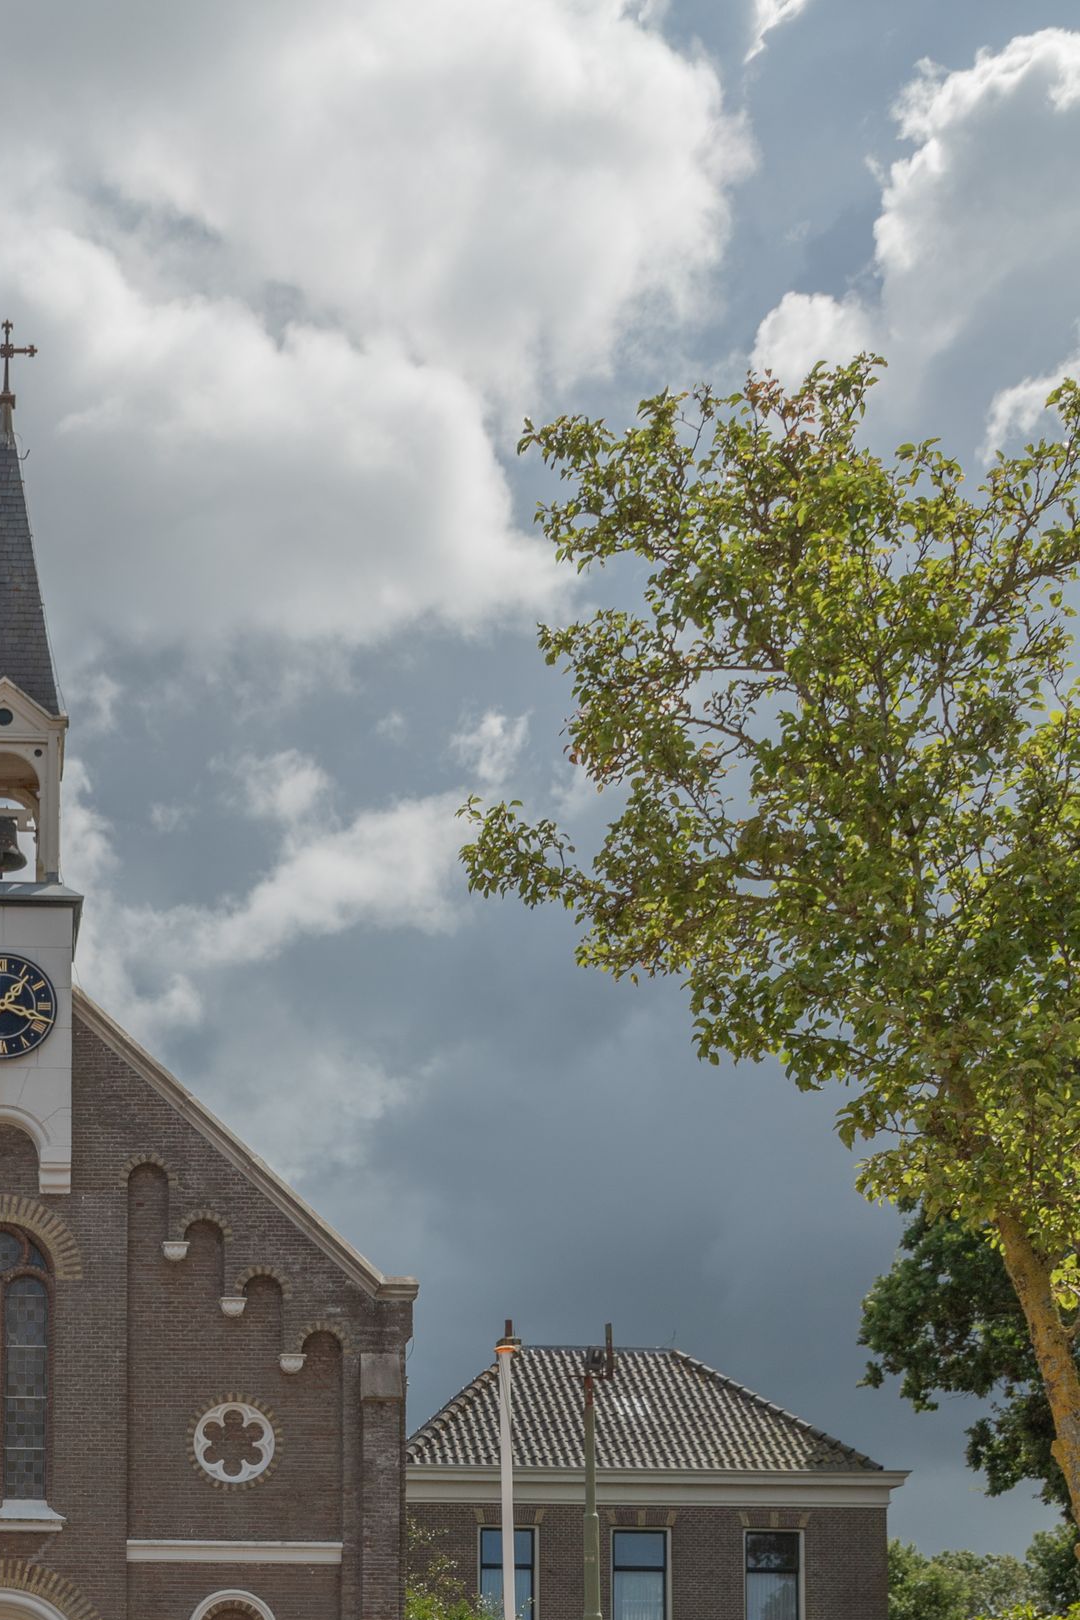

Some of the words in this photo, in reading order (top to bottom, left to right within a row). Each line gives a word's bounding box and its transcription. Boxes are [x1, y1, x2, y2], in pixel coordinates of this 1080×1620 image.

[19, 964, 28, 977] I
[32, 980, 46, 991] II
[37, 1002, 52, 1011] III
[0, 1040, 8, 1054] VI
[20, 1036, 30, 1048] V
